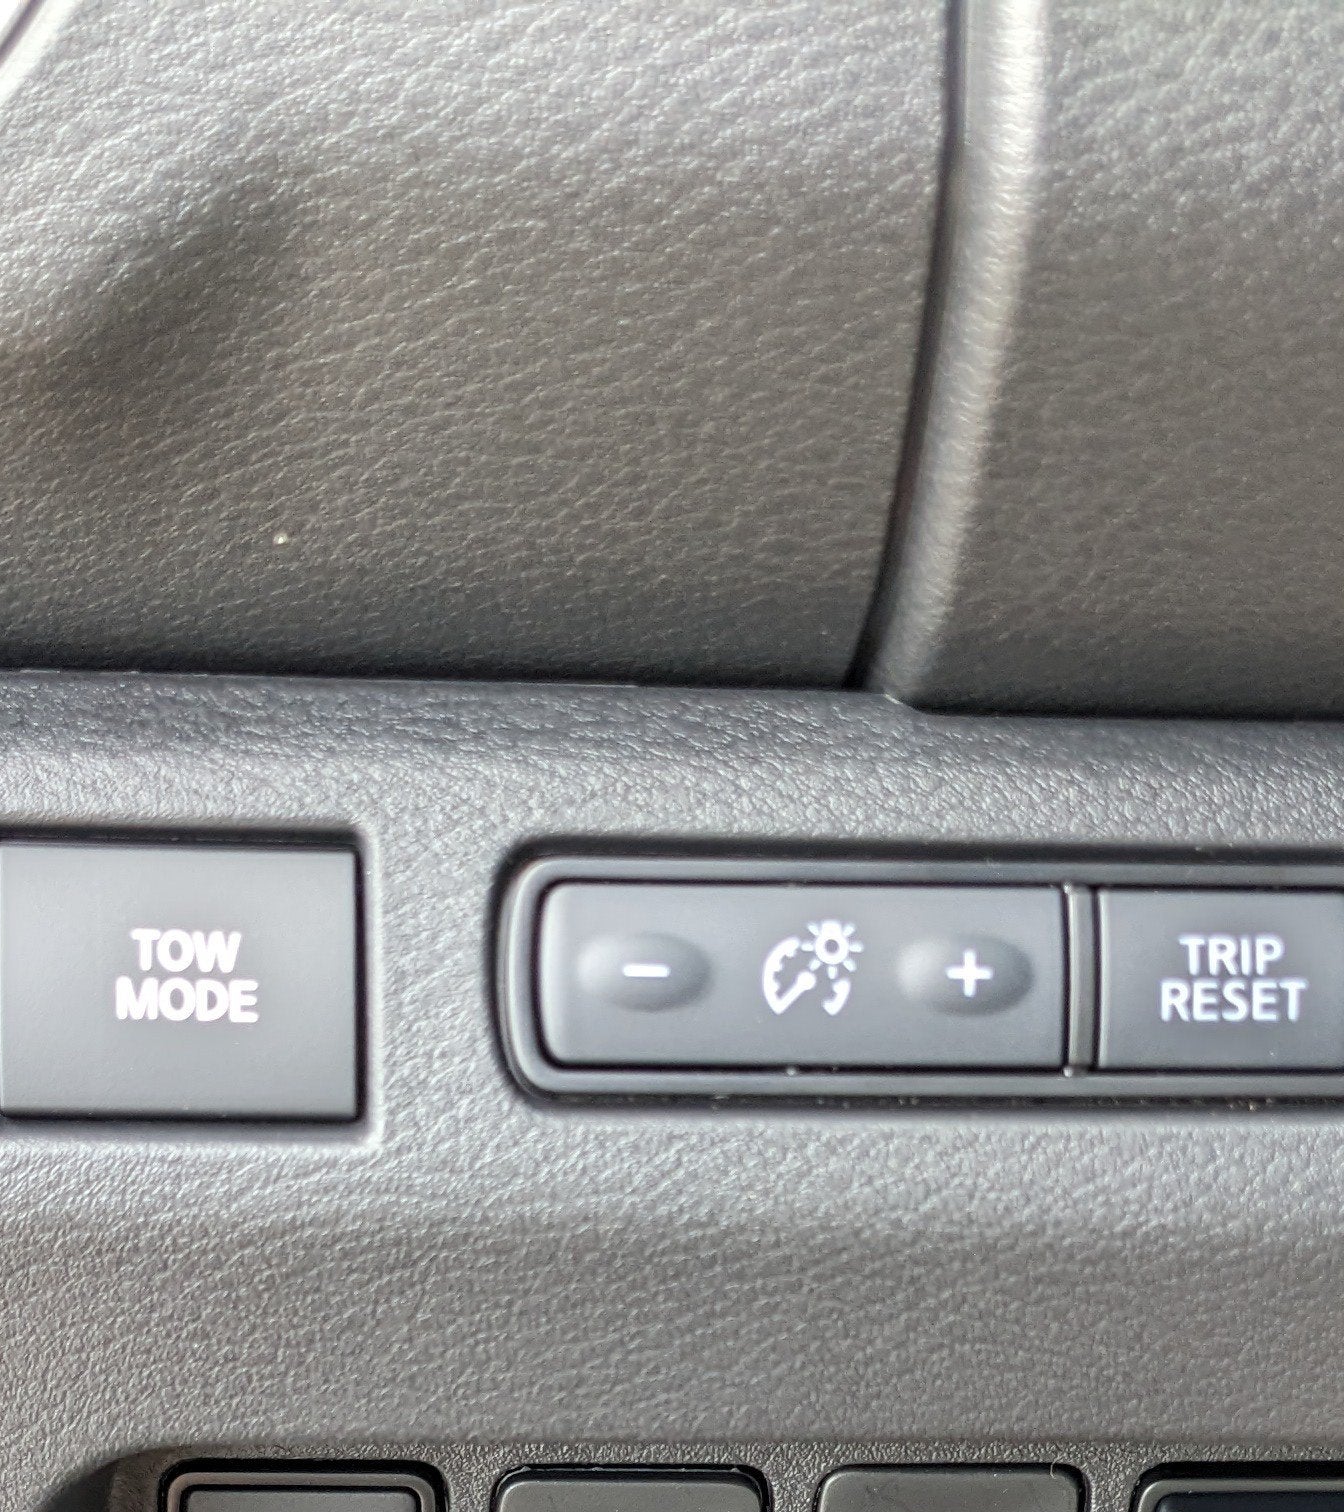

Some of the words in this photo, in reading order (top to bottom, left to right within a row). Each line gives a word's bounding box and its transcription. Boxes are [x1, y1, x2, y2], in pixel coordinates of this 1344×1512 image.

[130, 928, 242, 974] TOW
[1179, 933, 1285, 976] TRIP
[115, 976, 260, 1024] MODE
[1160, 979, 1307, 1023] RESET
